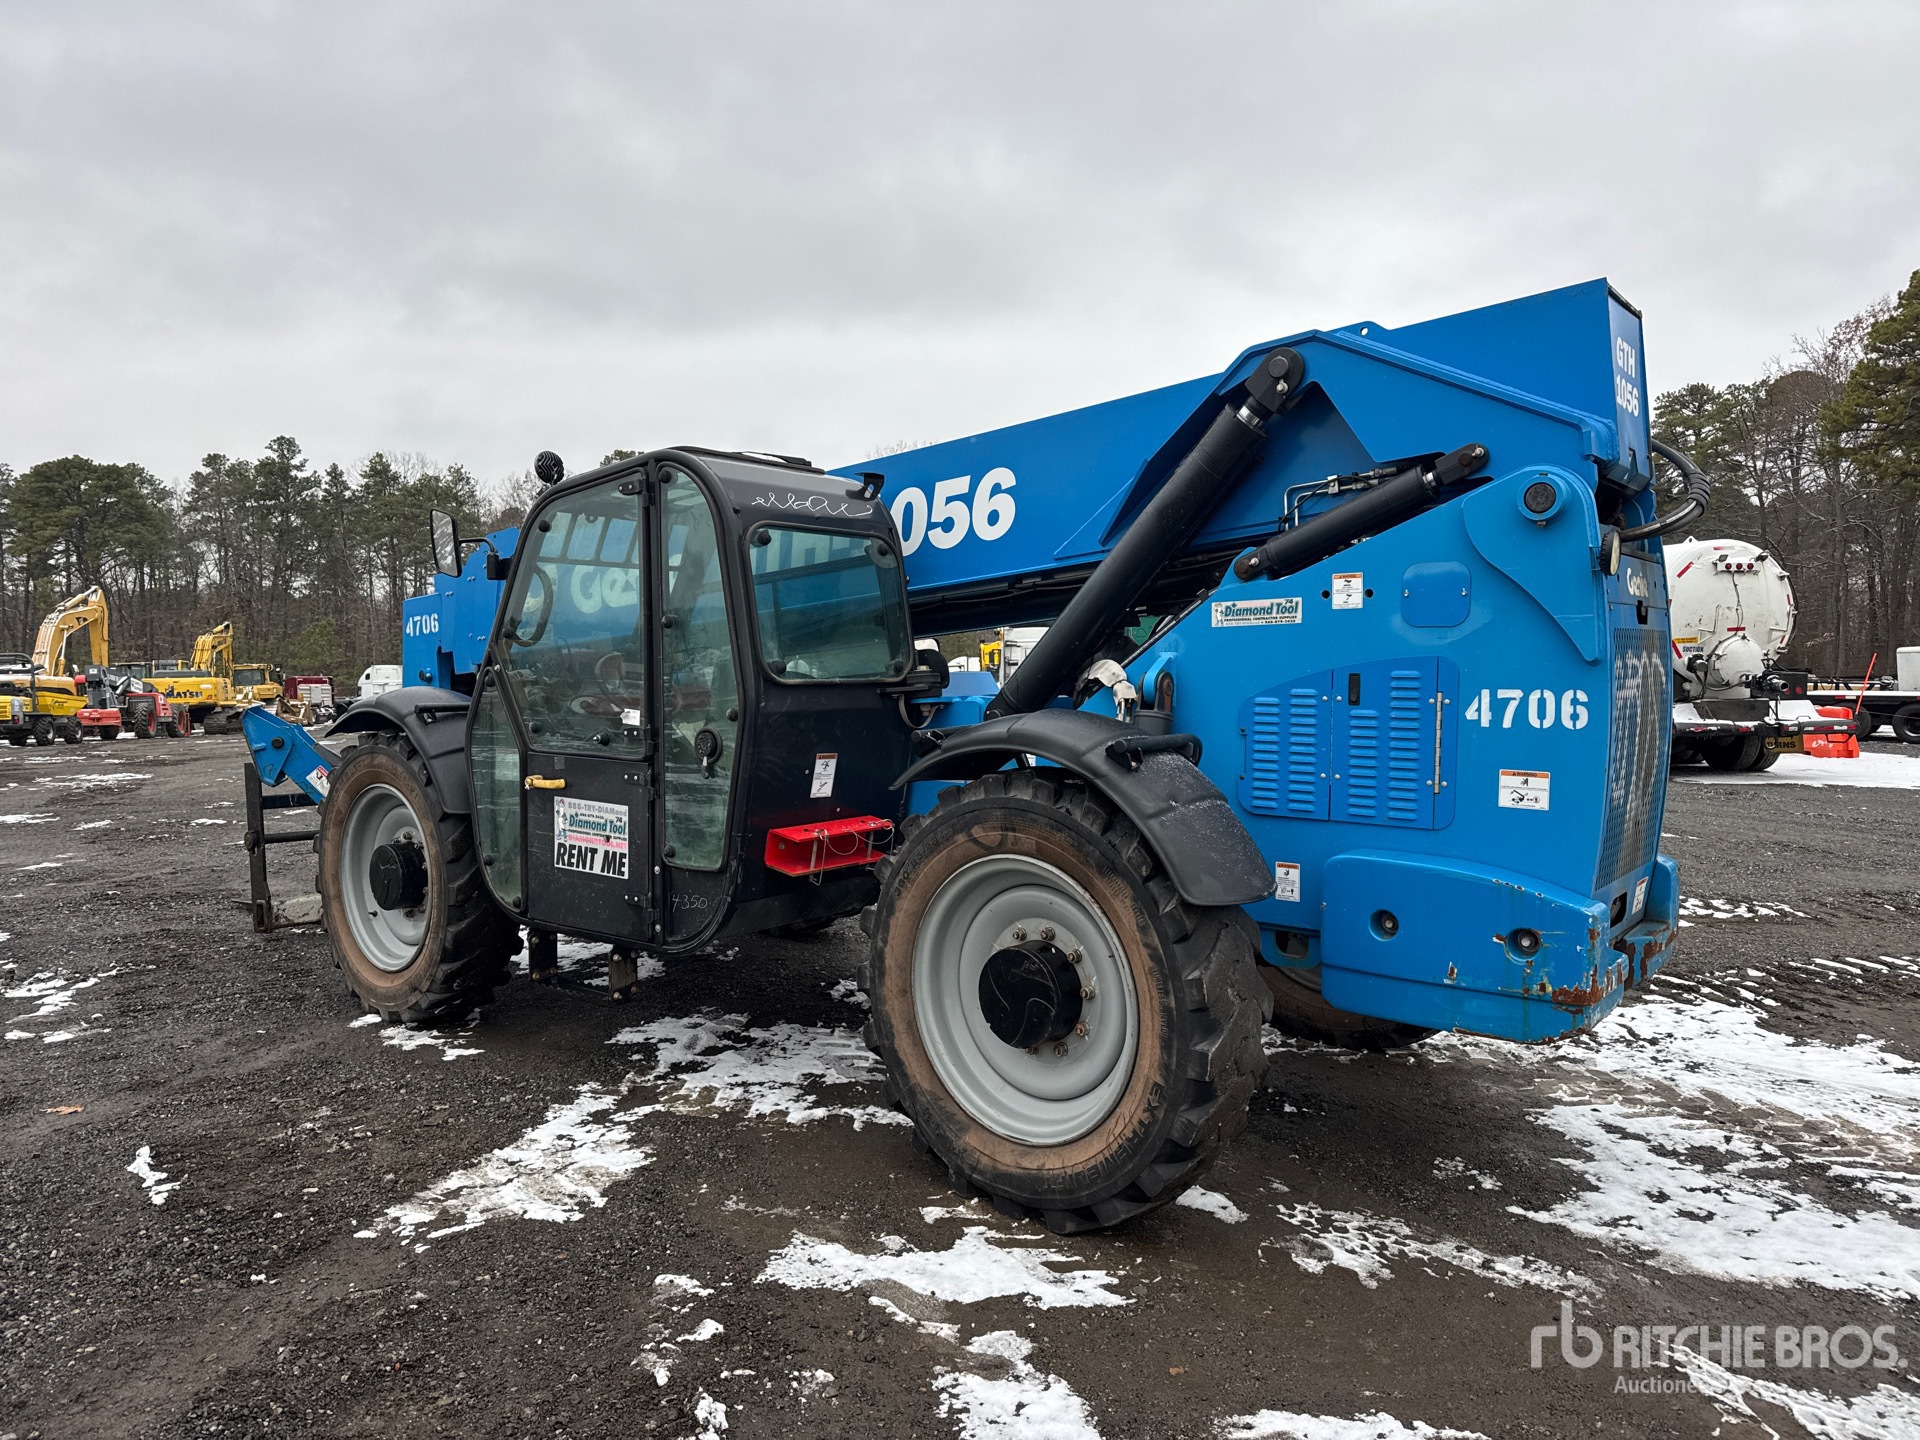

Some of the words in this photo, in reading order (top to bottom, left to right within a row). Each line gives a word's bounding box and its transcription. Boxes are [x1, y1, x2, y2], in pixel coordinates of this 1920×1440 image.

[1616, 336, 1636, 379] GTH
[1616, 374, 1639, 417] 1056
[1626, 567, 1649, 597] Genie
[1224, 602, 1274, 617] Diamond
[1275, 601, 1299, 614] Tool
[405, 612, 440, 637] 4706
[1464, 688, 1589, 731] 4706
[569, 812, 608, 832] Diamond
[609, 820, 627, 835] Tool
[556, 842, 598, 871] RENT
[600, 850, 627, 877] ME
[671, 894, 708, 913] 4350
